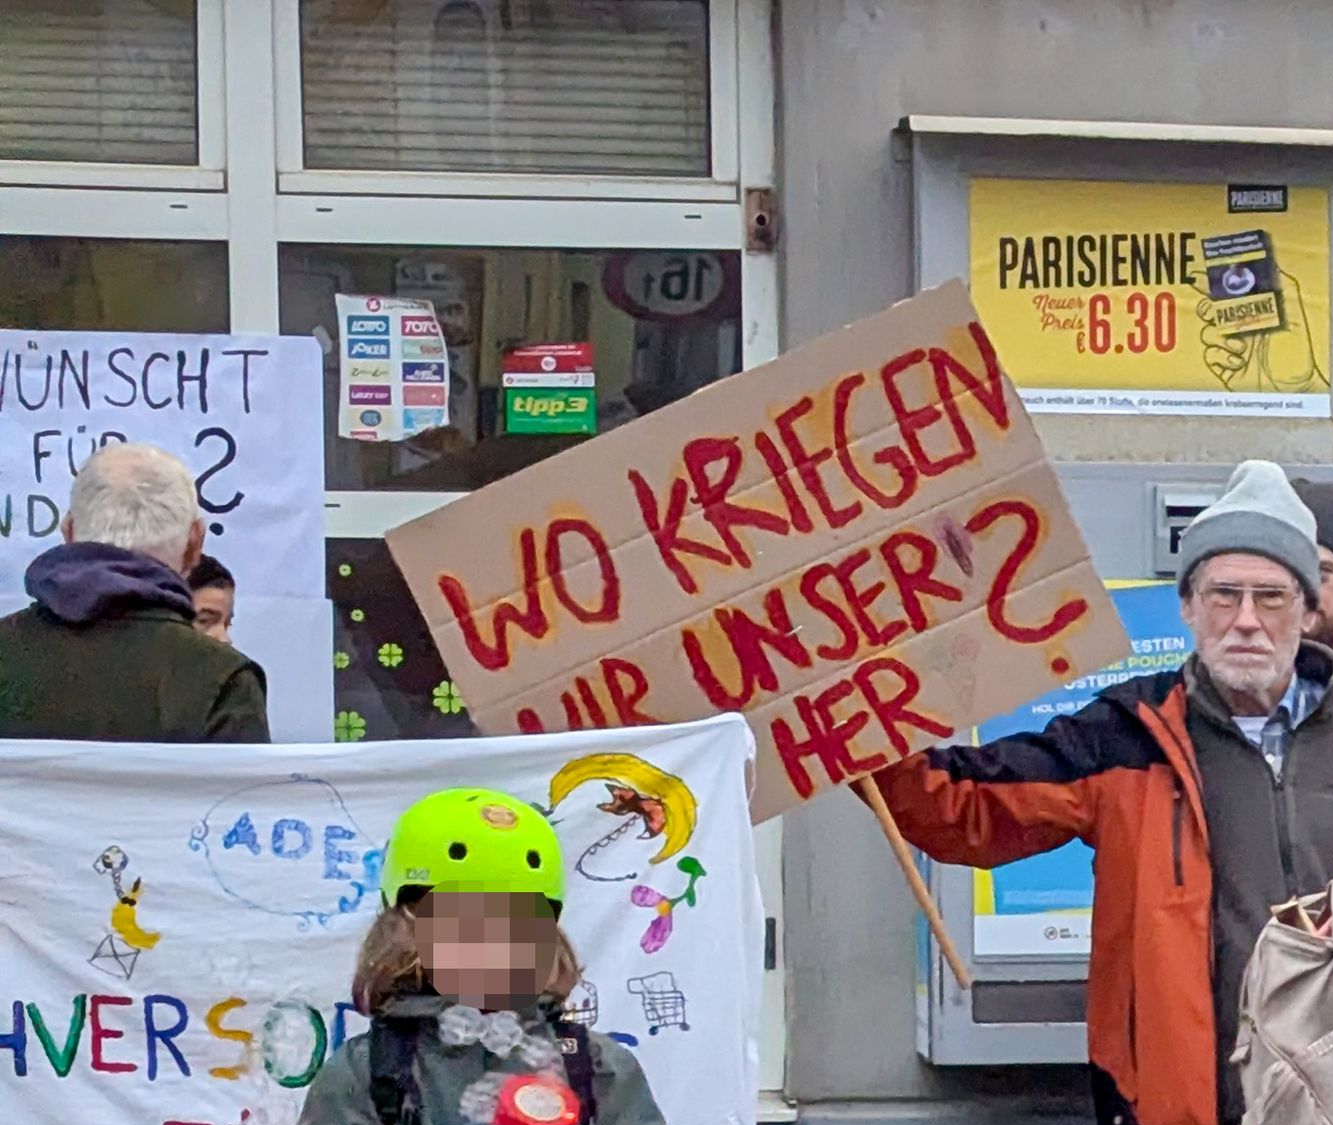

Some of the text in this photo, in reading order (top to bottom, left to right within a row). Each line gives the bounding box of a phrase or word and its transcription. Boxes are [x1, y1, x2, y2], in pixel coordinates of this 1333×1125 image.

[999, 232, 1198, 289] PARISIENNE
[1032, 294, 1087, 312] Neuer
[1041, 312, 1085, 331] Preis
[1088, 291, 1177, 355] 6.30
[513, 396, 588, 416] tipp3
[33, 424, 128, 484] FÜ
[438, 322, 1010, 671] WO KRIEGEN
[682, 531, 964, 711] UNSER
[771, 657, 955, 800] HER
